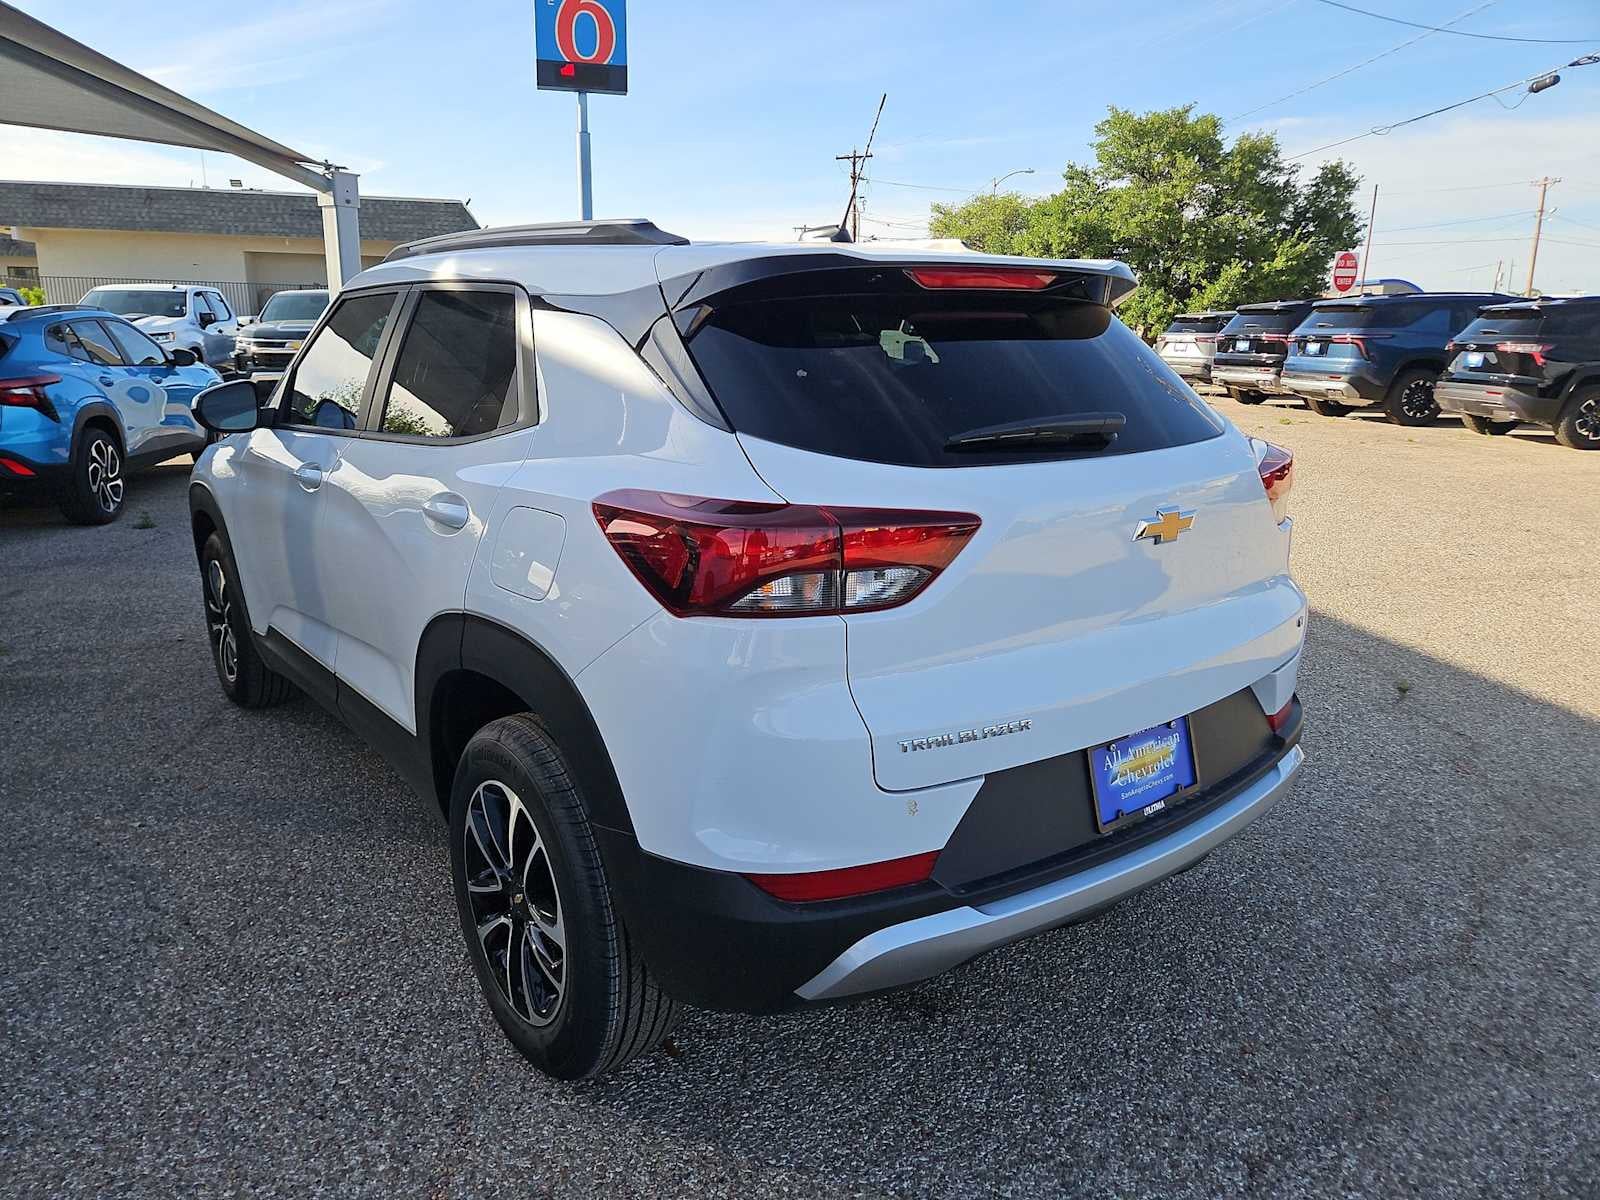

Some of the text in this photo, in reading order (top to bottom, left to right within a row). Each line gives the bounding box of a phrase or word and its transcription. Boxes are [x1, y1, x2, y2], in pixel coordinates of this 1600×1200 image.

[555, 0, 616, 65] 6
[897, 719, 1032, 752] TRAILBLAZER
[1103, 732, 1180, 770] All American
[1117, 754, 1174, 786] Chevrolet
